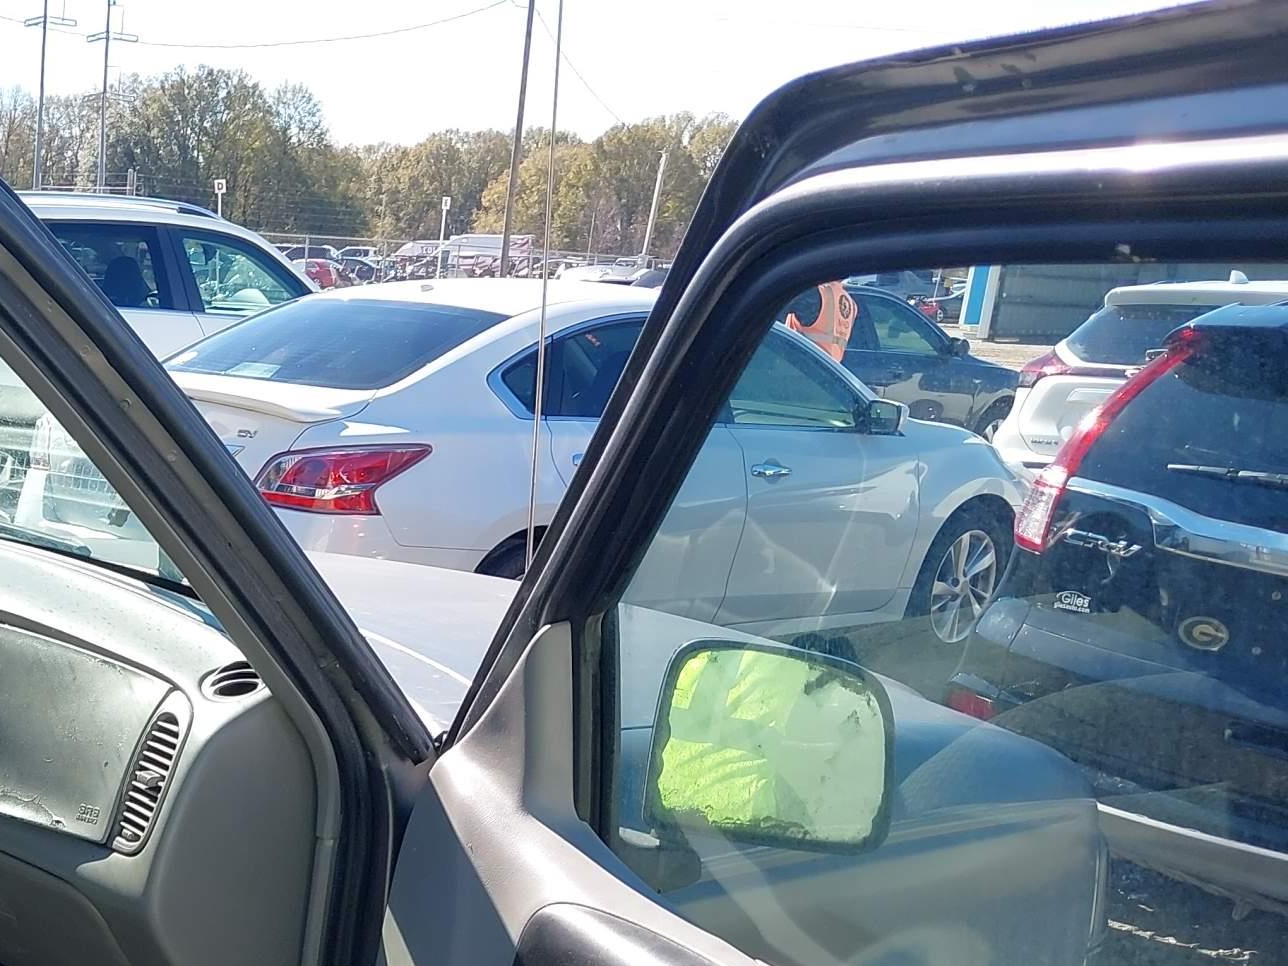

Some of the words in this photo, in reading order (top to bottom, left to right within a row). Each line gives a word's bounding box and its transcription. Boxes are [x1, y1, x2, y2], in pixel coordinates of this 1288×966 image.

[216, 182, 224, 191] D
[237, 429, 258, 438] SV
[1061, 593, 1090, 608] Giles
